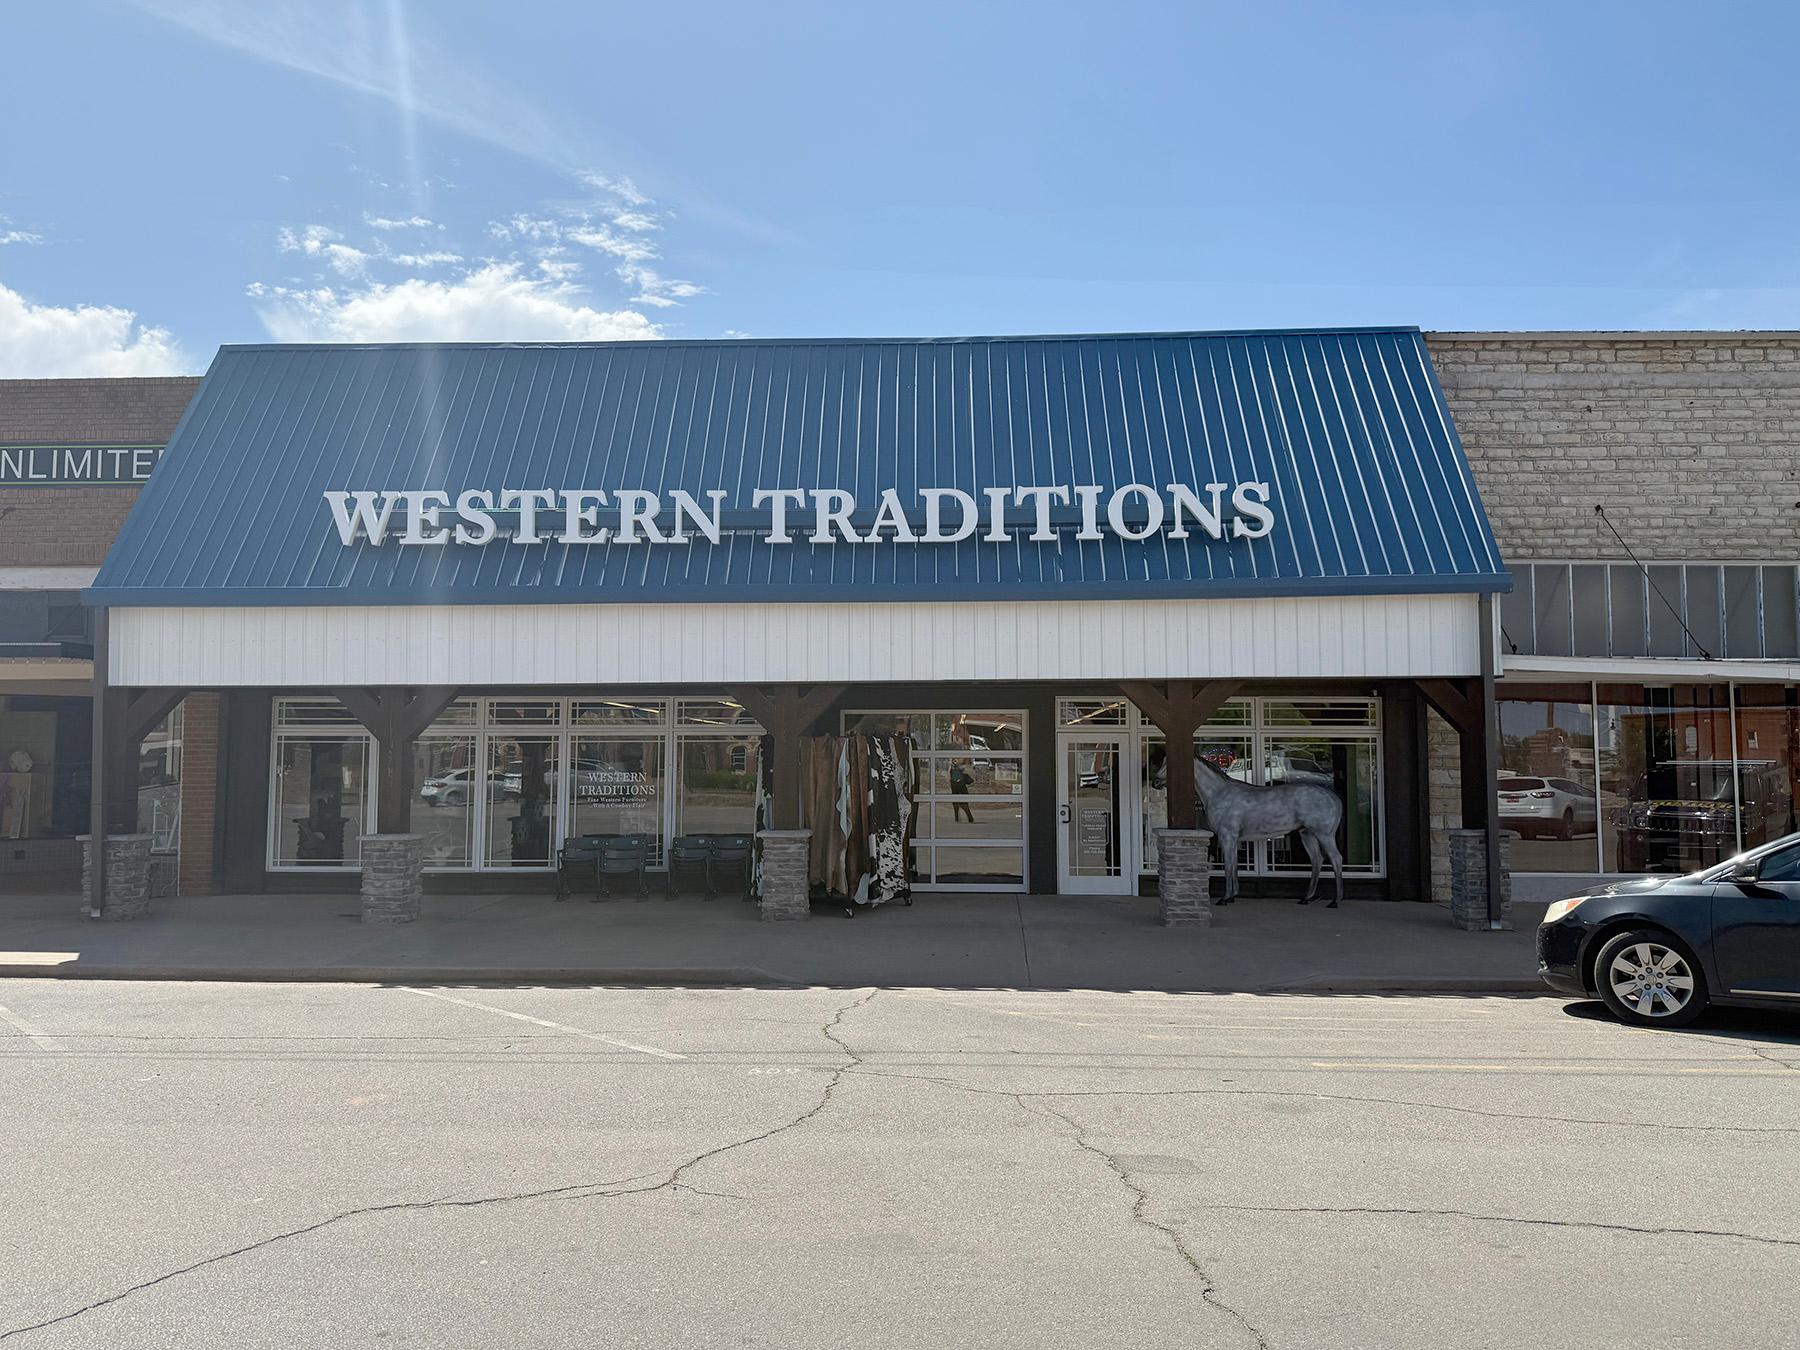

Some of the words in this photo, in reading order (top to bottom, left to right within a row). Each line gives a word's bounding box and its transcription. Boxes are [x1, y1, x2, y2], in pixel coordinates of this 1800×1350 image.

[0, 449, 164, 479] NLIMITE
[323, 488, 728, 547] WESTERN
[752, 481, 1275, 545] TRADITIONS
[587, 771, 648, 782] WESTERN
[579, 784, 656, 796] TRADITIONS
